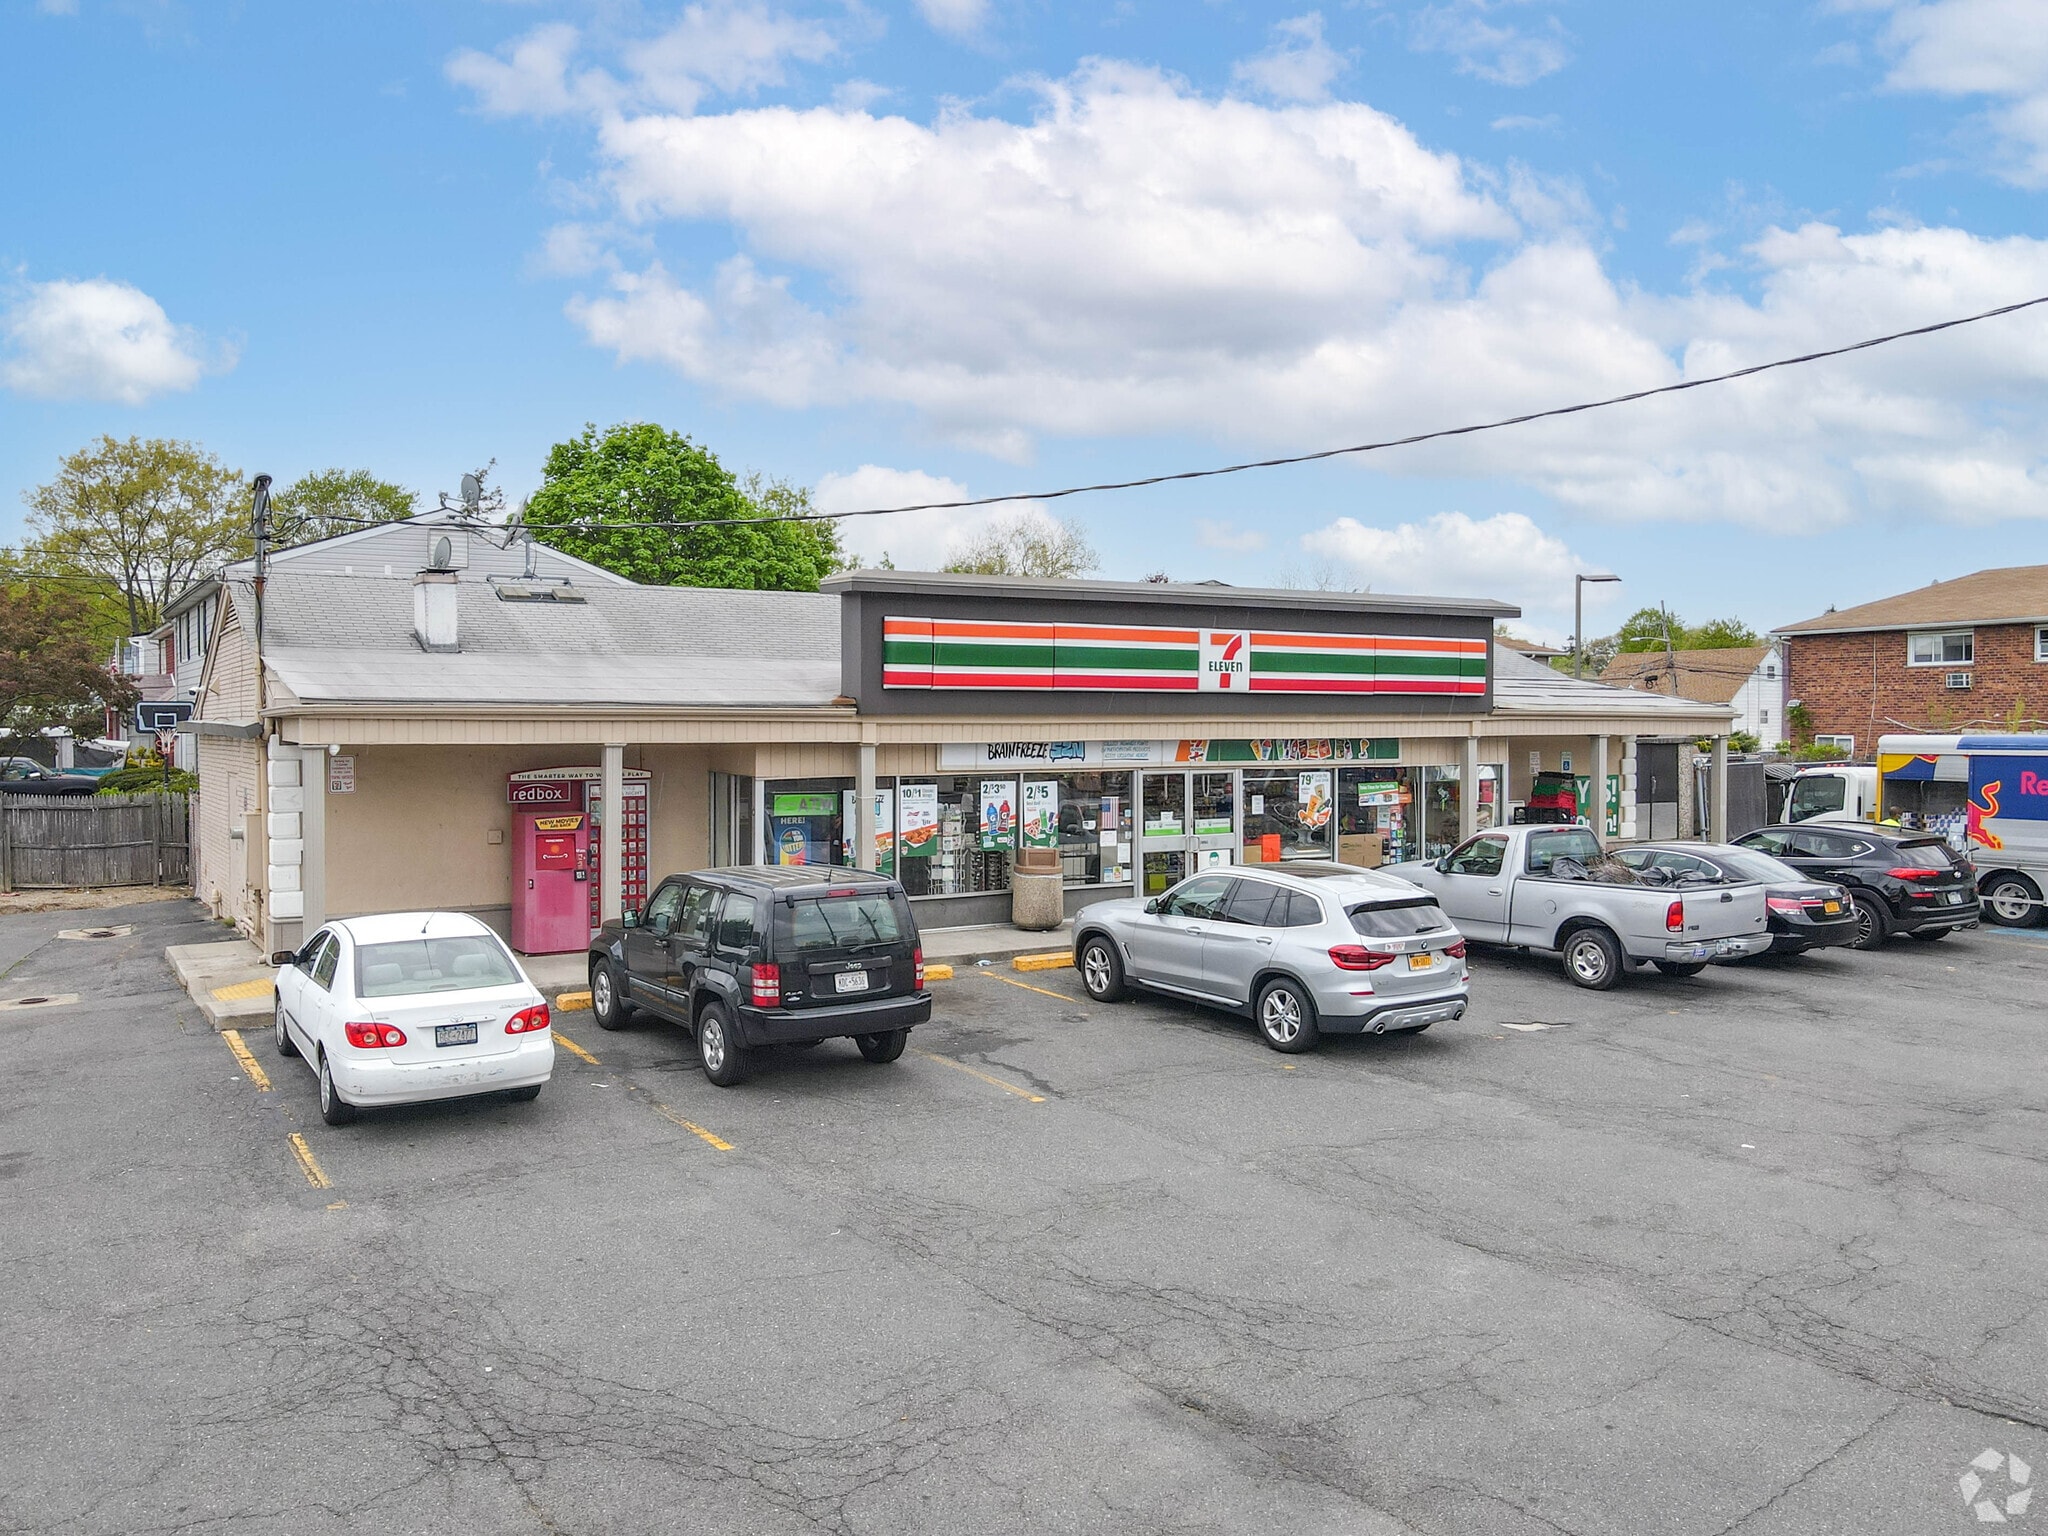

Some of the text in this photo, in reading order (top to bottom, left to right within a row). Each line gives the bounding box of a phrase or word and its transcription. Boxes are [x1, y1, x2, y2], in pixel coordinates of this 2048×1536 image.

[1210, 633, 1242, 688] 7
[513, 788, 562, 800] redbox
[798, 797, 834, 812] ATM
[780, 817, 806, 825] HERE!
[845, 962, 862, 970] Jeep
